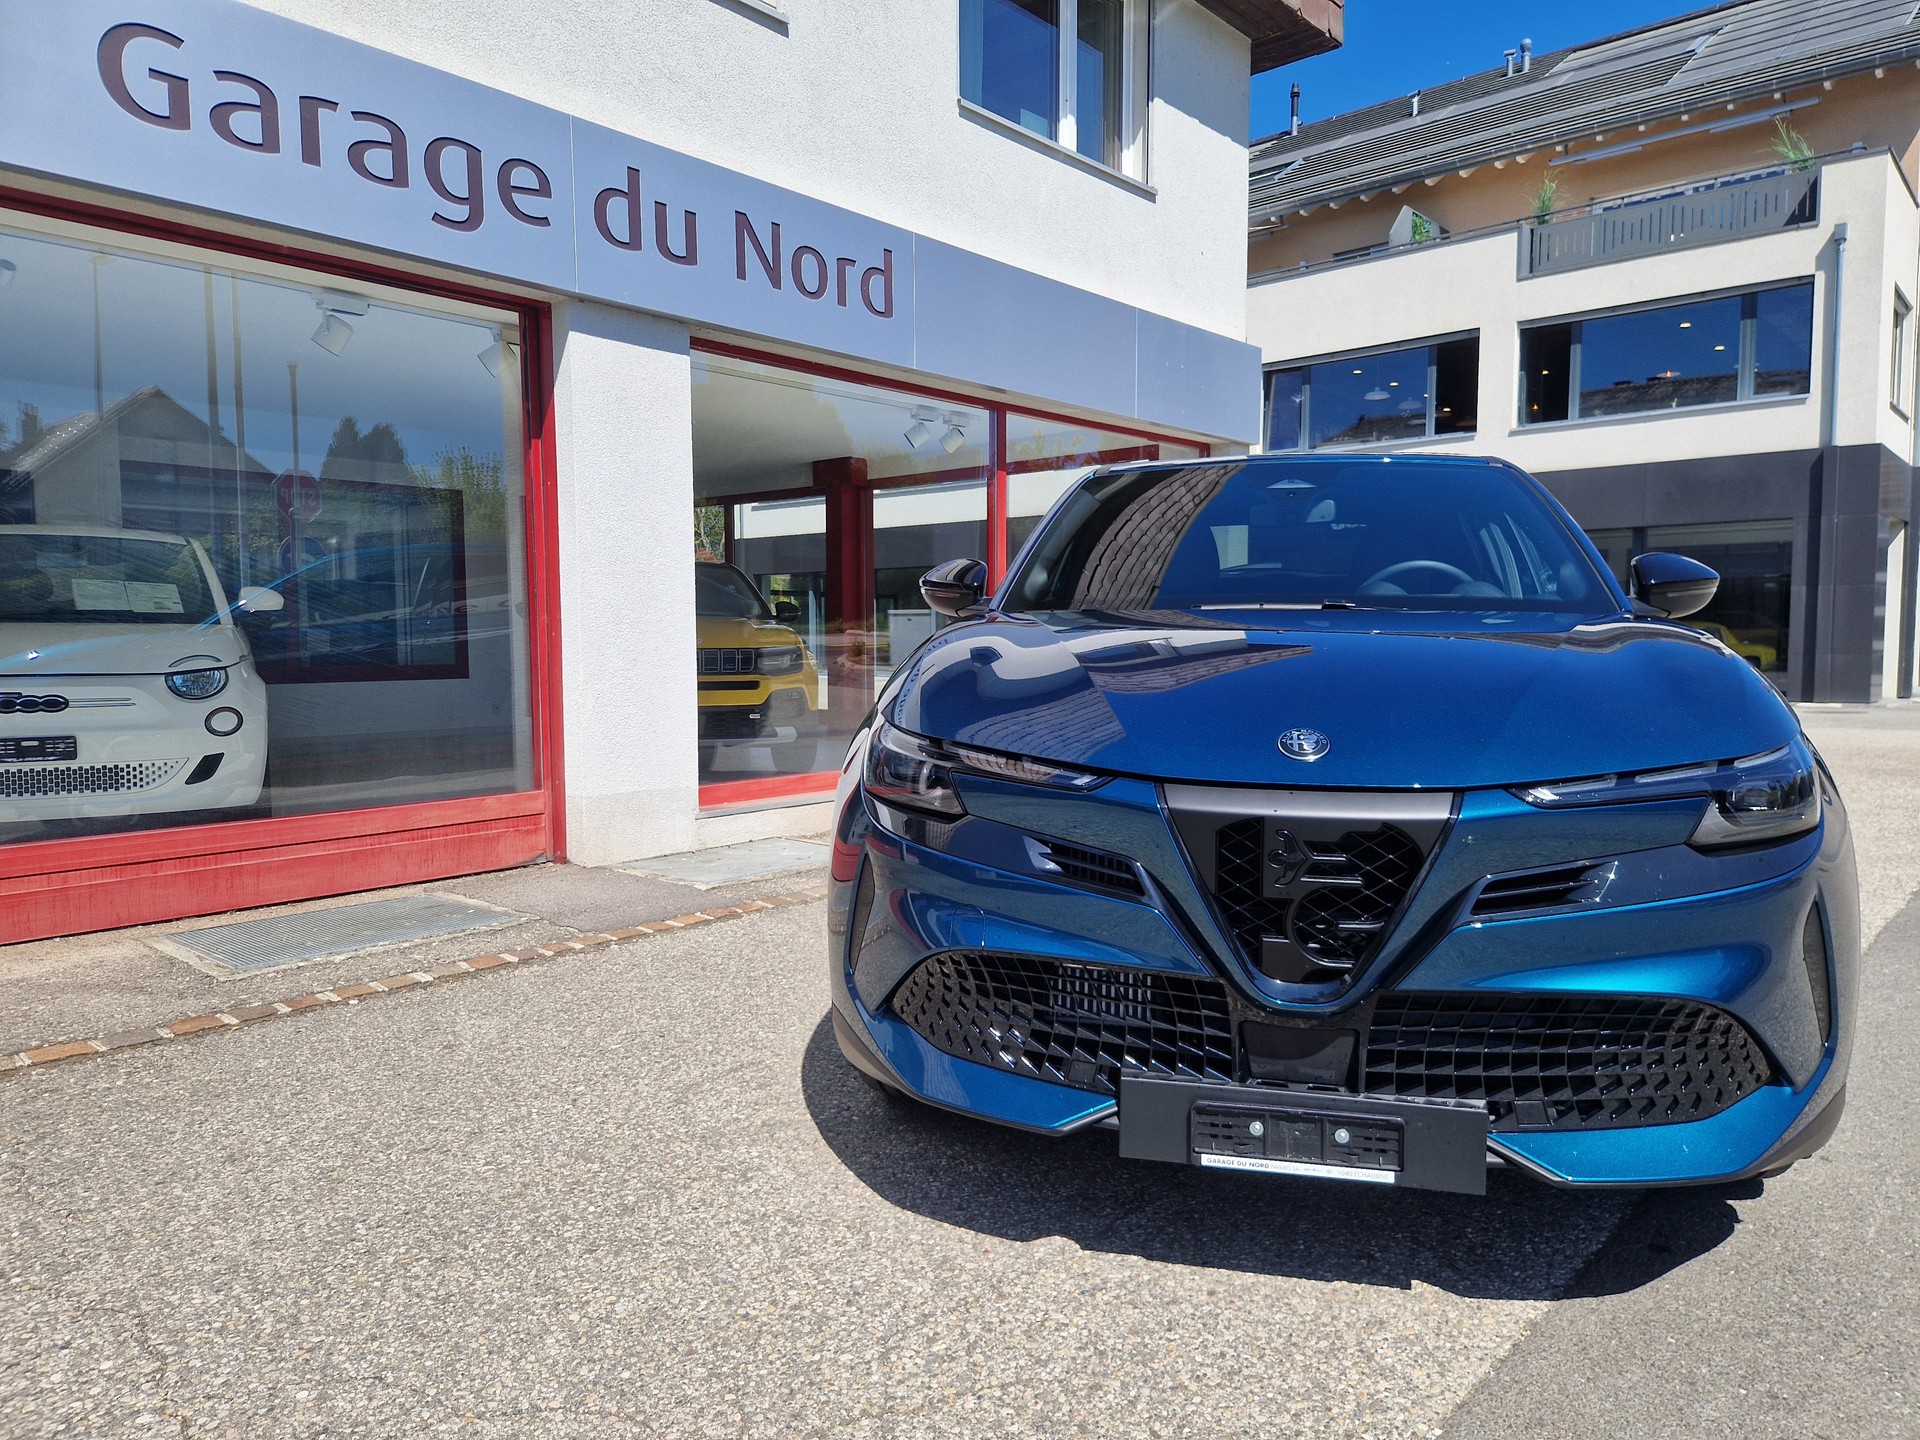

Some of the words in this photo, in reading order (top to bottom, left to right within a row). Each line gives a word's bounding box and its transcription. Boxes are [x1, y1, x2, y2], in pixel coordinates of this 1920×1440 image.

[96, 21, 553, 233] Garage
[592, 166, 699, 268] du
[734, 209, 895, 319] Nord
[1300, 729, 1327, 744] ROMEO
[1206, 1157, 1235, 1166] GARAGE
[1248, 1161, 1270, 1169] NORD
